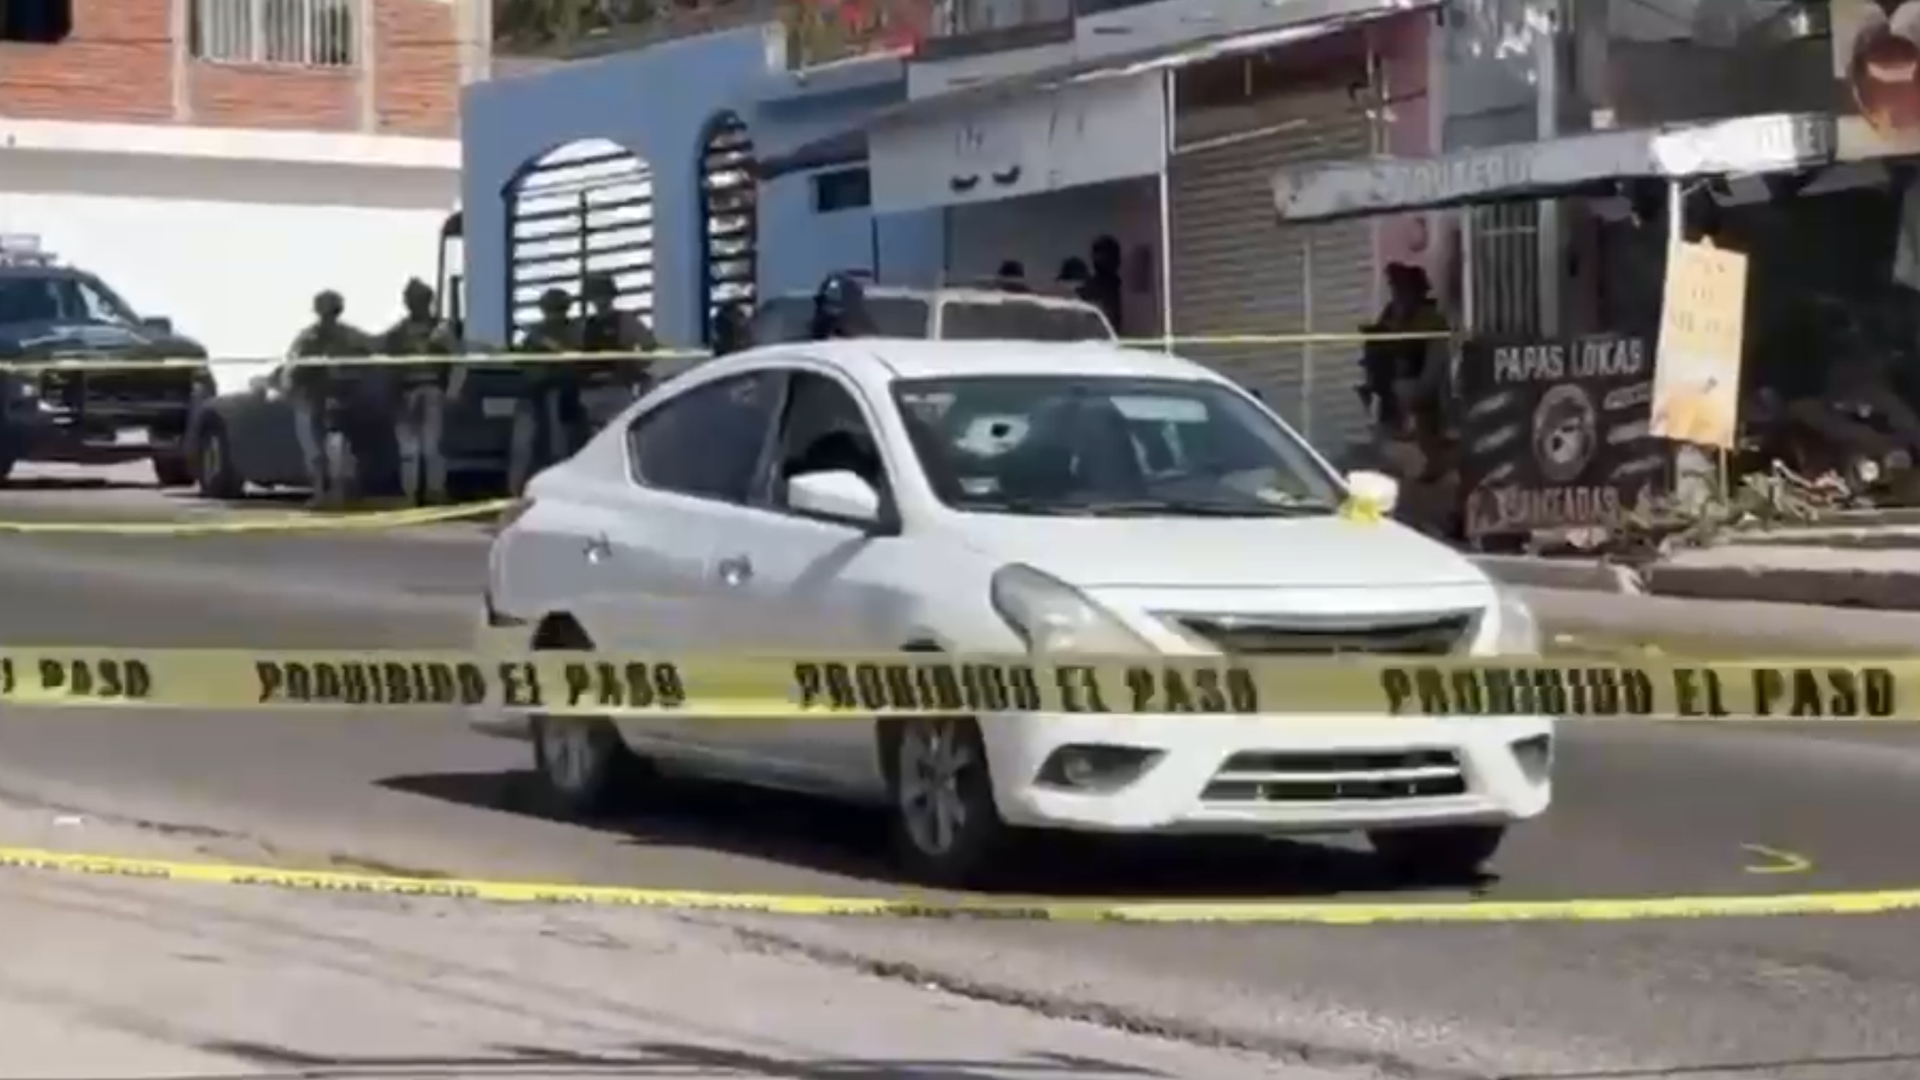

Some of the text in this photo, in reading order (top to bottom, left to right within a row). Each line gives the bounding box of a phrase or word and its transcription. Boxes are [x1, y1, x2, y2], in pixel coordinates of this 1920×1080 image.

[1494, 338, 1643, 384] PAPAS LOKAS
[256, 661, 686, 707] PROHIBIDO EL PASO
[795, 663, 1257, 713] PROHIBIDO EL PASO
[1382, 668, 1896, 717] PROHIBIDO EL PASO
